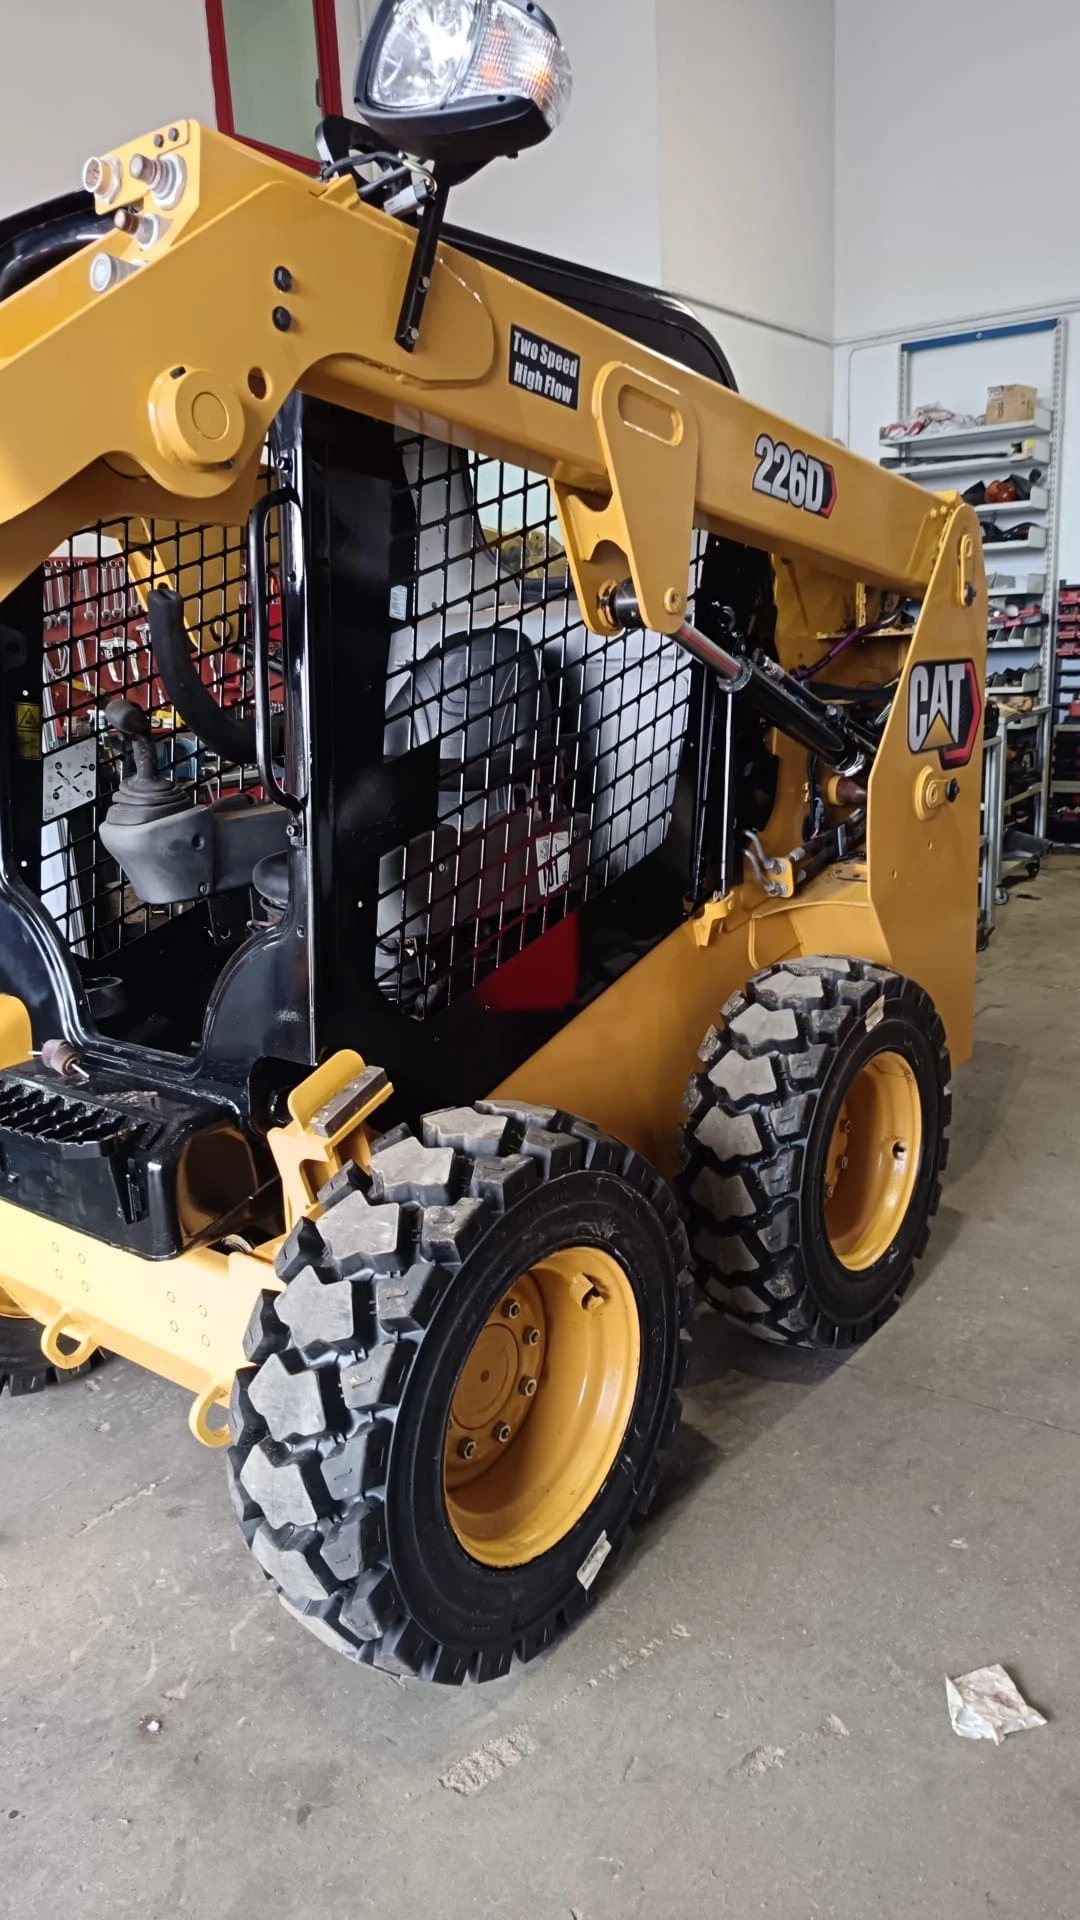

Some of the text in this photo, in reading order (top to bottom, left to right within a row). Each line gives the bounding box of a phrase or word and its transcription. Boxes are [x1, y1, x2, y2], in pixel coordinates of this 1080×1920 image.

[513, 330, 578, 378] Two Speed
[513, 361, 572, 404] High Flow
[753, 435, 824, 513] 226D
[909, 663, 966, 752] CAT
